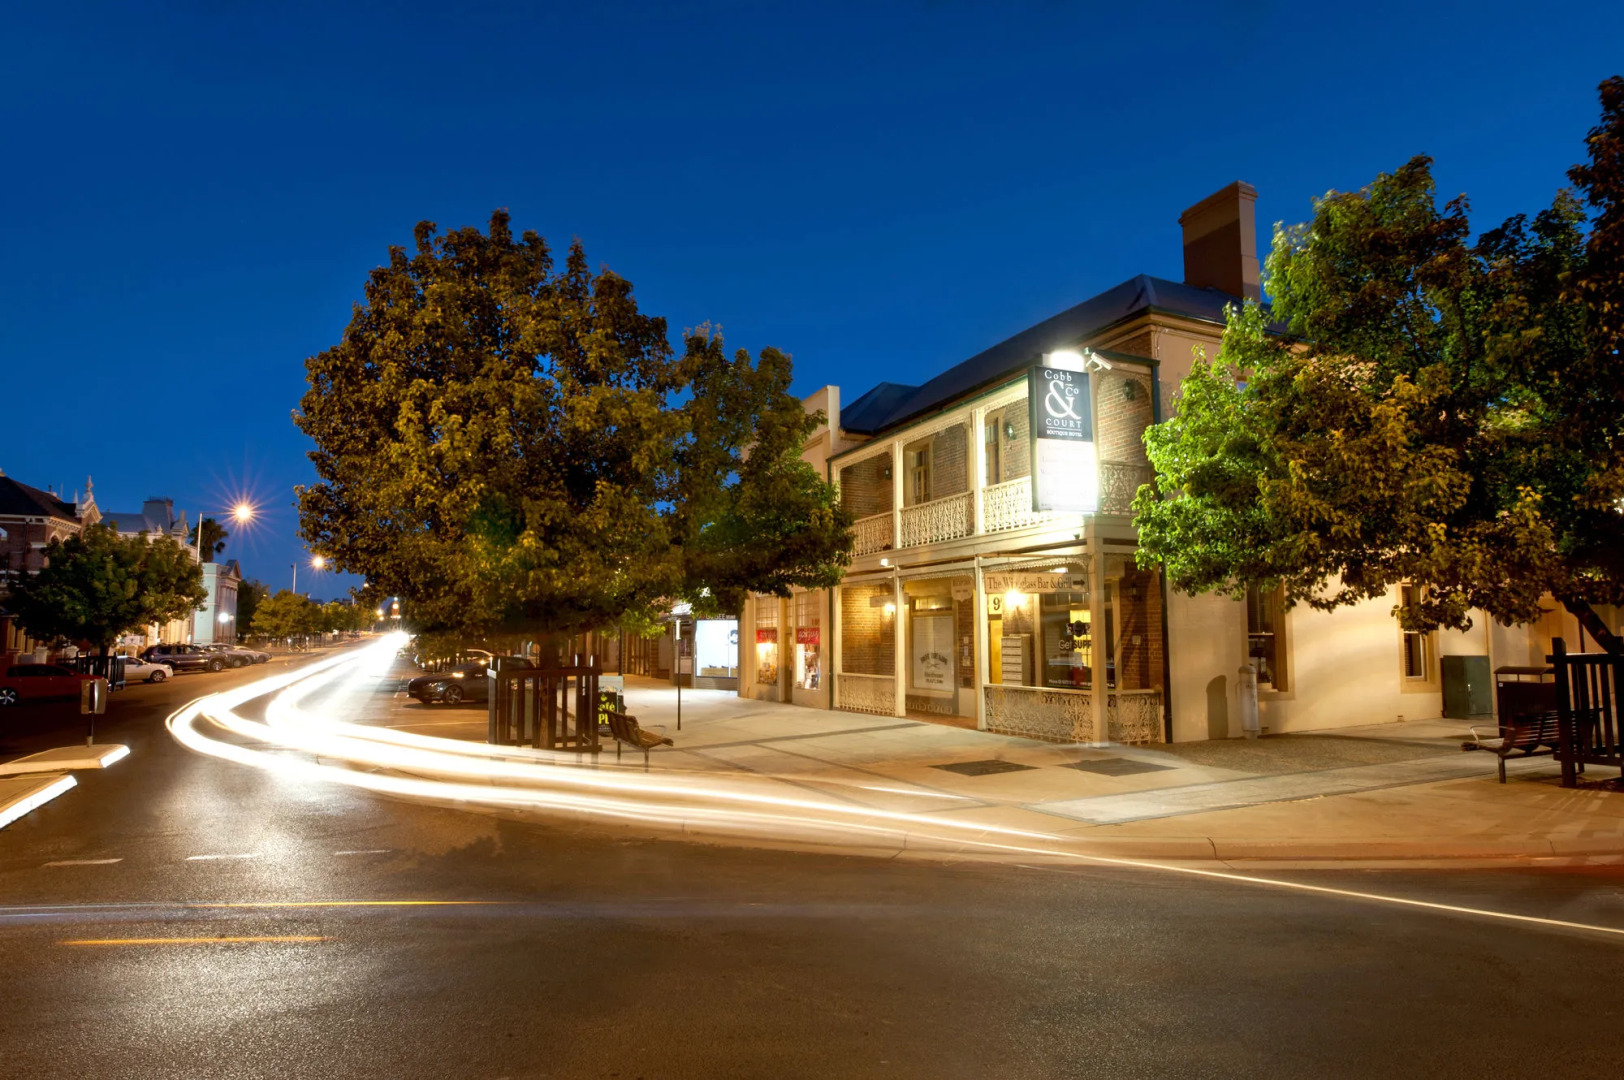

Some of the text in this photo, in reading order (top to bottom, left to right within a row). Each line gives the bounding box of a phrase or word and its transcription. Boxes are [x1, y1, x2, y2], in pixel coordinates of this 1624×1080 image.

[1044, 370, 1072, 381] Cobb
[1065, 386, 1079, 397] Co
[1045, 380, 1082, 420] &
[1045, 418, 1082, 428] COURT
[987, 577, 1072, 590] The Wiglass Bar & Grill
[993, 597, 1001, 611] 9
